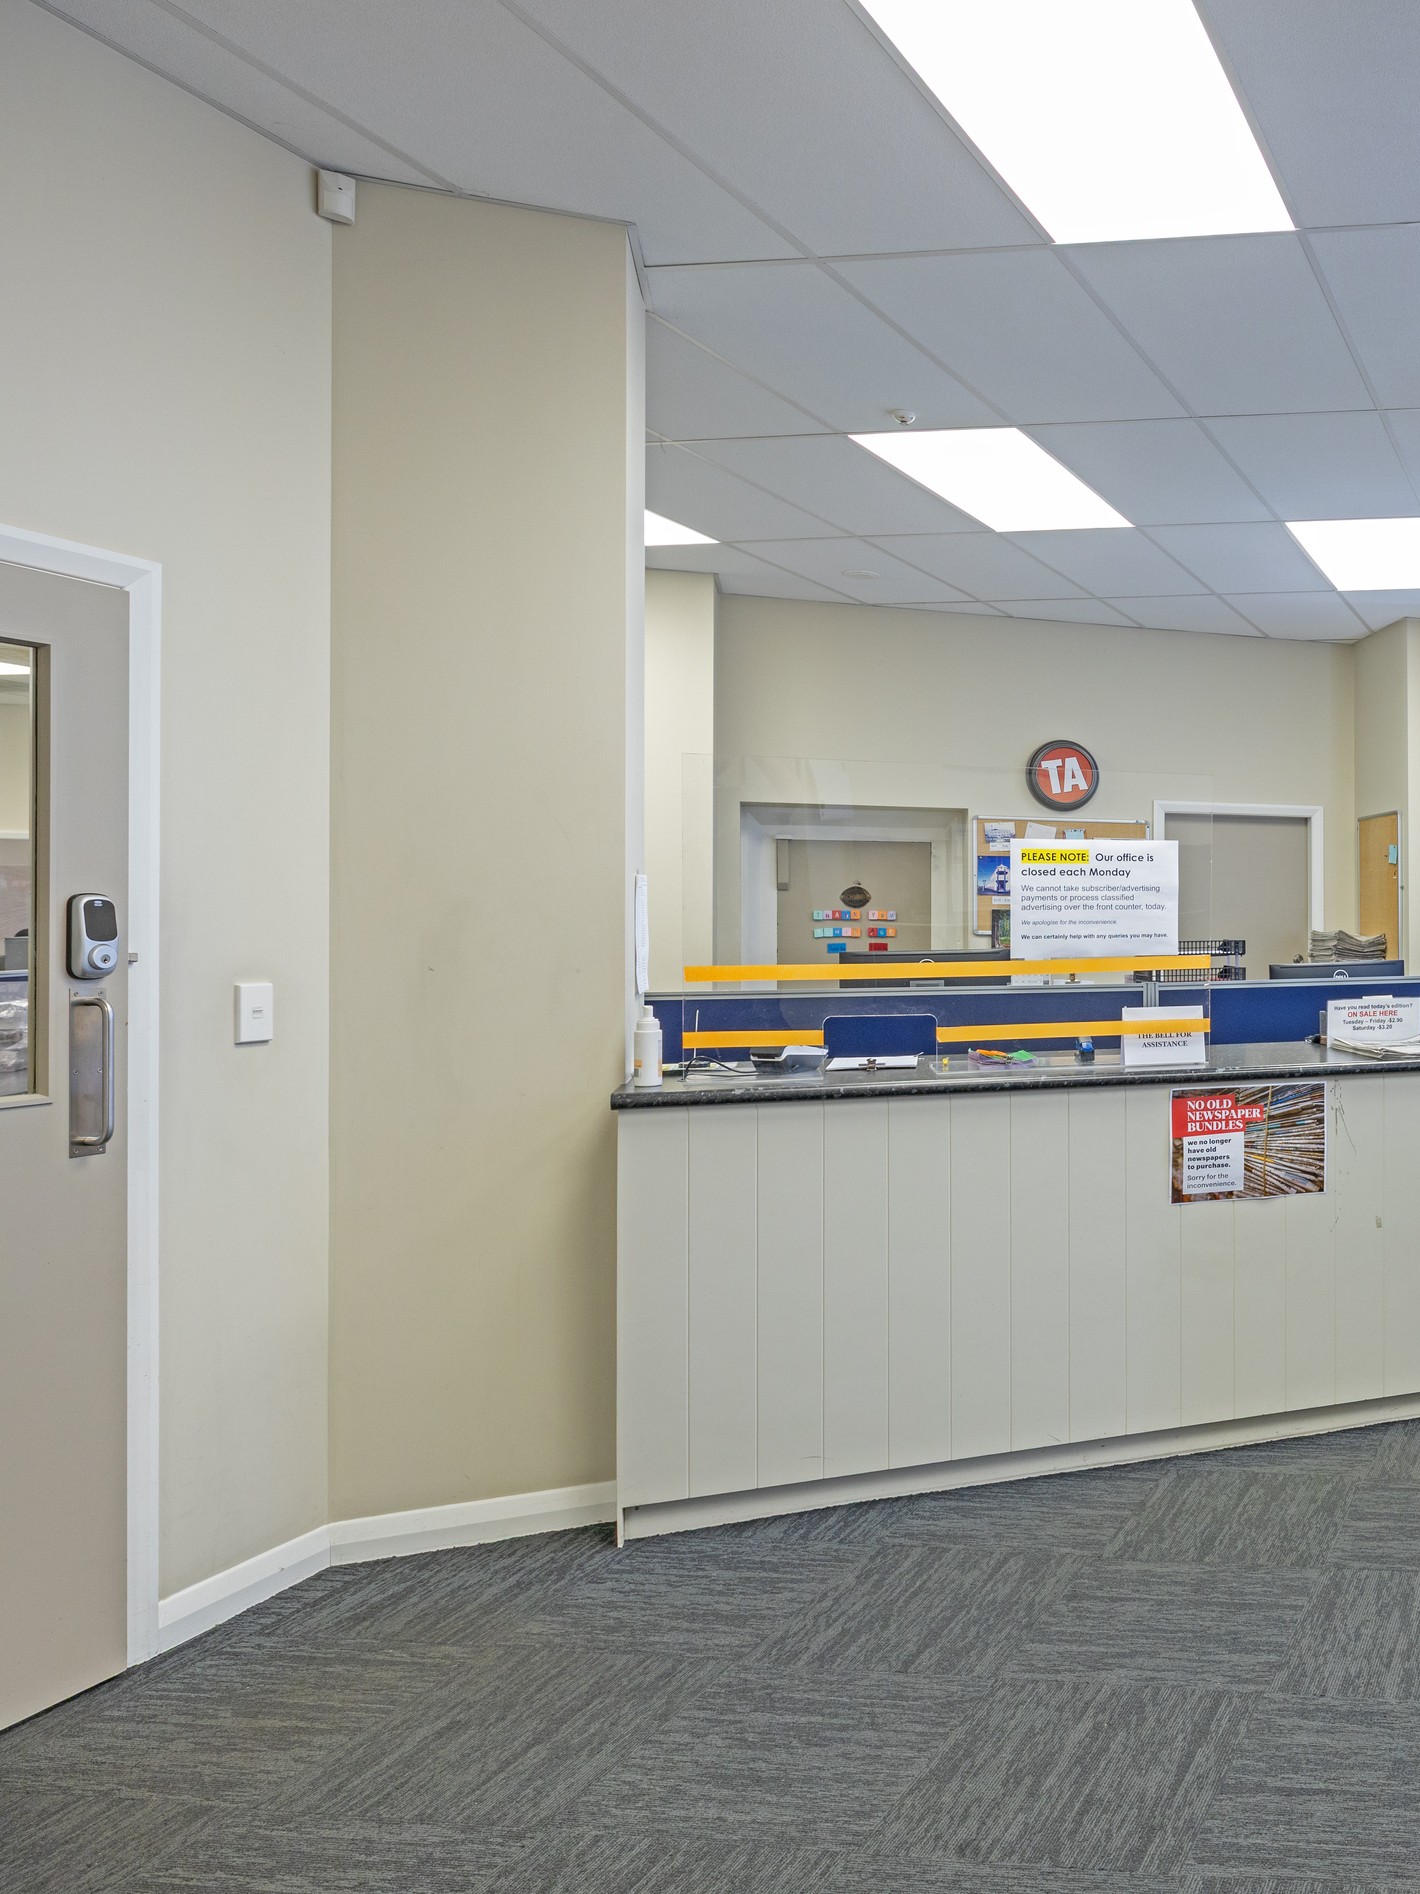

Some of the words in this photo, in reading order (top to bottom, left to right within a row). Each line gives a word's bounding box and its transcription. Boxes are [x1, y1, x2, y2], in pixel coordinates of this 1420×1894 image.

[1041, 757, 1088, 794] TA
[1021, 853, 1056, 862] PLEASE
[1060, 853, 1089, 862] NOTE:
[1095, 853, 1113, 862] Our
[1117, 853, 1144, 862] office
[1147, 853, 1154, 862] is
[1021, 868, 1056, 876] closed
[1060, 868, 1086, 876] each
[1089, 868, 1131, 878] Monday
[1064, 884, 1079, 892] take
[1082, 884, 1160, 893] subscriber/advertising
[1021, 894, 1058, 903] payments
[1070, 895, 1098, 903] process
[1021, 904, 1062, 912] advertising
[1146, 903, 1166, 911] today.
[1032, 919, 1058, 927] apologise
[1142, 1040, 1188, 1048] ASSISTANCE
[1187, 1100, 1204, 1111] NO
[1207, 1099, 1232, 1109] OLD
[1187, 1108, 1261, 1121] NEWSPAPER
[1188, 1120, 1243, 1132] BUNDLES
[1196, 1162, 1230, 1170] purchase.
[1187, 1180, 1236, 1189] inconvenience.
